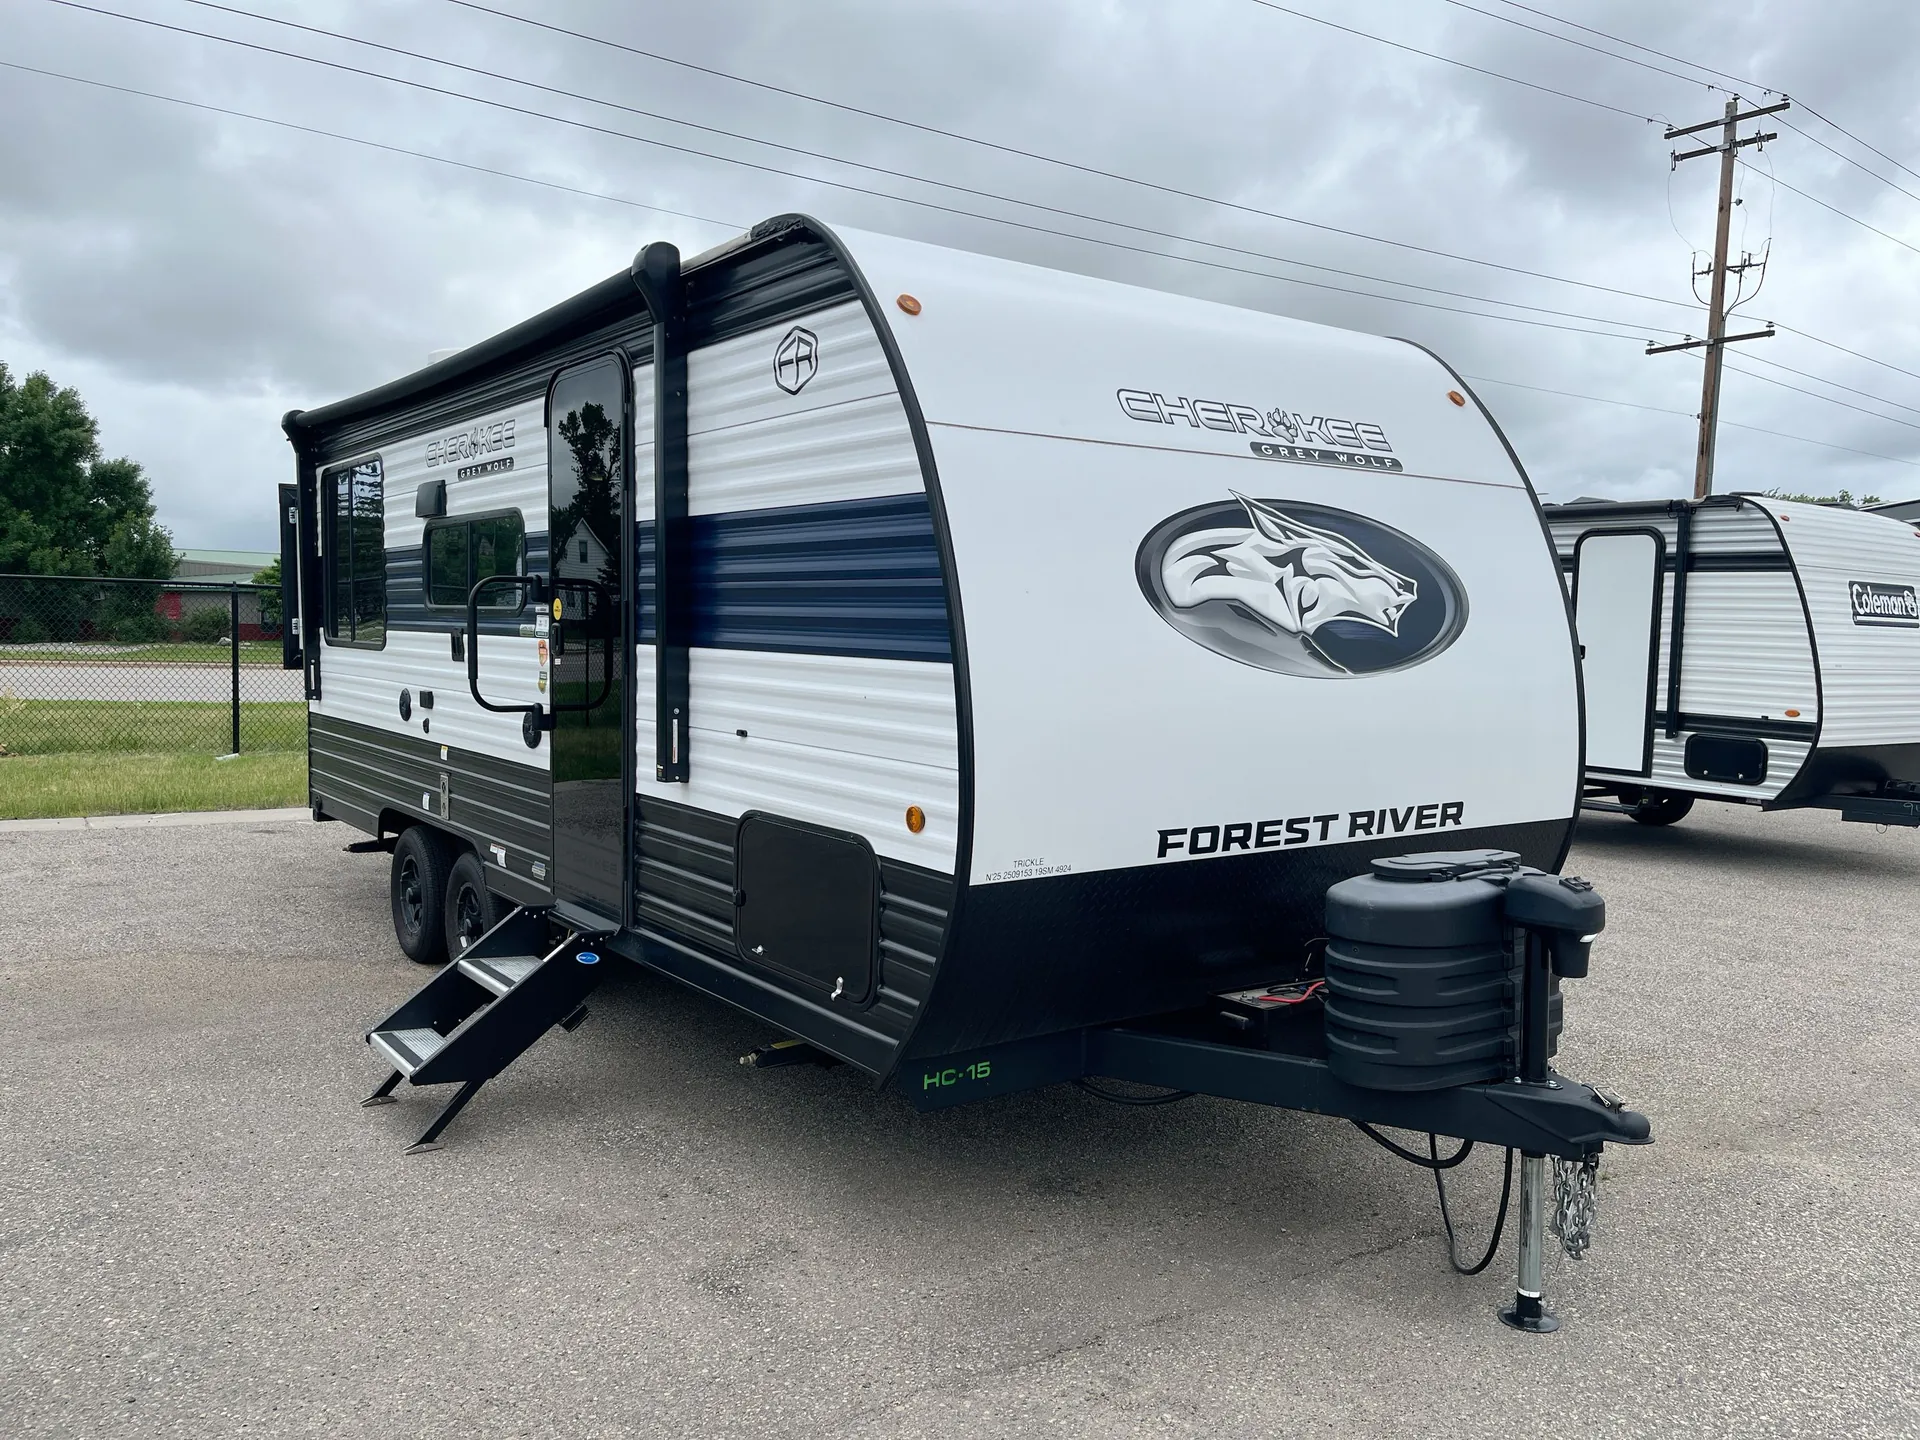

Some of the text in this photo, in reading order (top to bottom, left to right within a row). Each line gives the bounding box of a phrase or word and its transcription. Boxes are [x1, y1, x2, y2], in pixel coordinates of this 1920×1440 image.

[1261, 444, 1393, 468] GREY WOLF
[460, 459, 511, 479] GREY WOLF
[1852, 584, 1907, 615] Coleman
[1157, 801, 1464, 859] FOREST RIVER
[1003, 868, 1033, 880] 2509153
[1035, 866, 1053, 876] 19SM
[1055, 864, 1072, 873] 4924
[1013, 858, 1044, 868] TRICKLE
